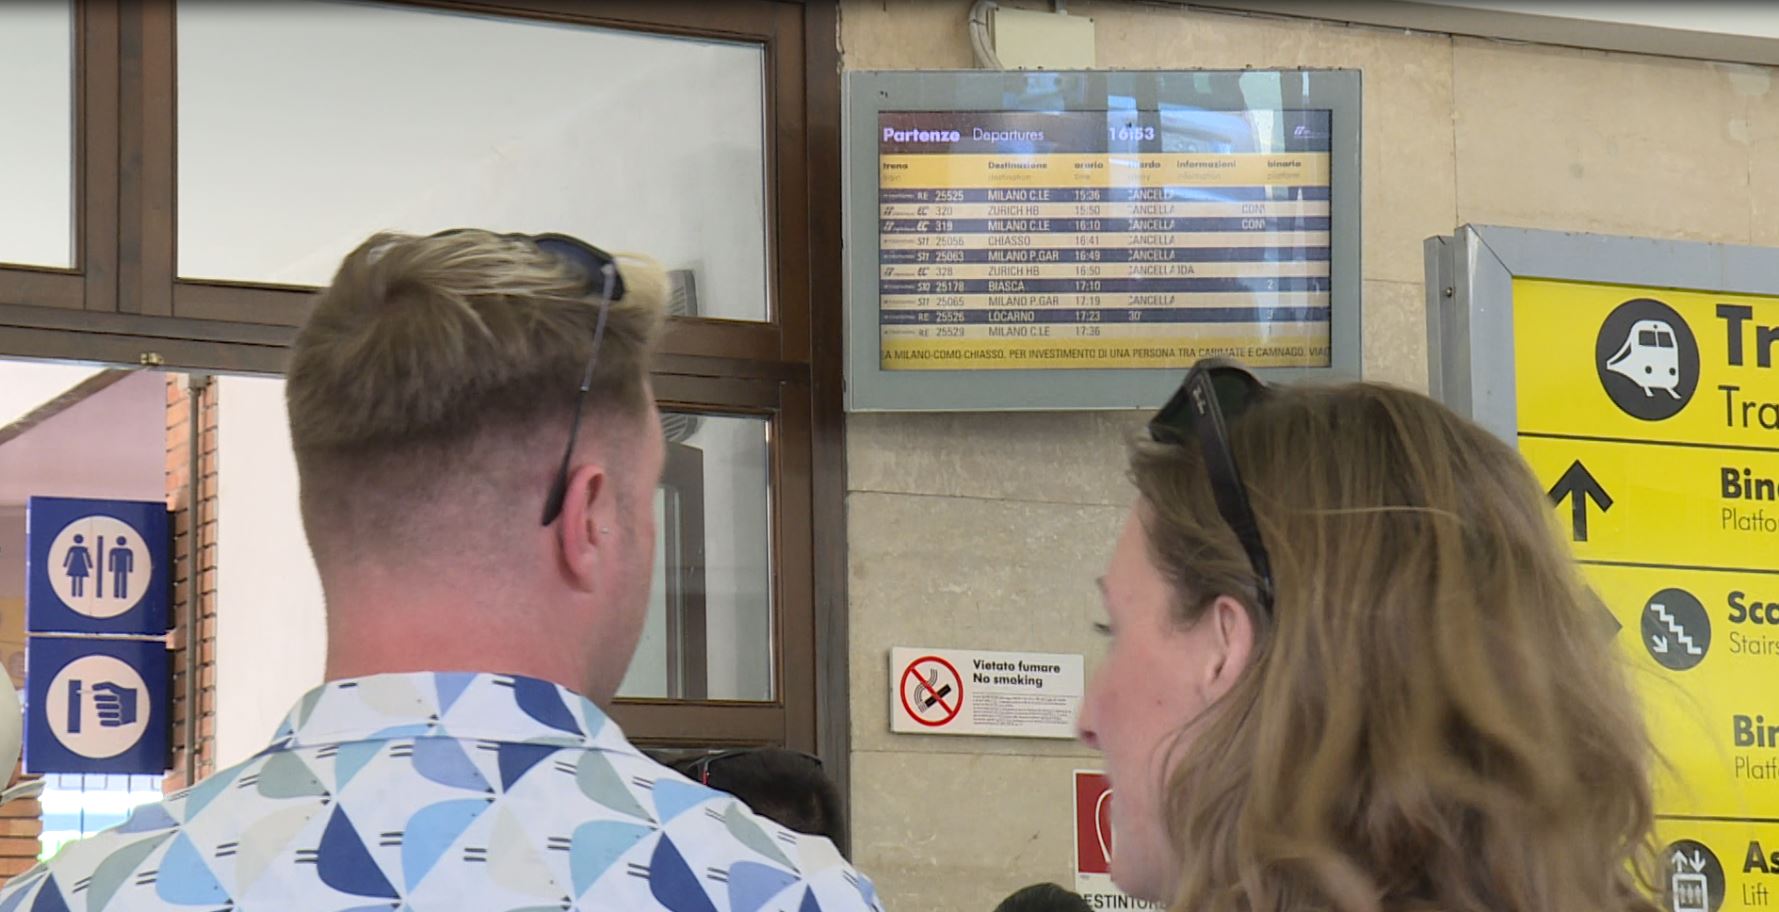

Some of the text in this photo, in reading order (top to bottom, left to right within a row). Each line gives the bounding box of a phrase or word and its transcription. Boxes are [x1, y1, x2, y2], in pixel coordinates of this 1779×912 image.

[883, 127, 1044, 143] Partenze Departures
[1109, 127, 1155, 141] 16:53
[1177, 160, 1236, 168] informazioni
[988, 190, 1027, 200] MILANO
[1029, 190, 1051, 200] C.LE
[988, 205, 1023, 216] ZURICH
[1026, 205, 1039, 216] HB
[1075, 205, 1100, 215] 15:50
[988, 220, 1027, 231] MILANO
[1029, 220, 1051, 231] C.LE
[1075, 220, 1100, 230] 16:10
[988, 235, 1031, 246] CHIASSO
[1075, 235, 1099, 246] 16:41
[988, 250, 1027, 261] MILANO
[1029, 250, 1059, 261] P.GAR
[988, 266, 1023, 276] ZURICH
[1026, 266, 1039, 276] HB
[988, 281, 1025, 292] BIASCA
[1075, 281, 1100, 291] 17:10
[988, 296, 1027, 307] MILANO
[988, 311, 1035, 322] LOCARNO
[988, 326, 1027, 337] MILANO
[1029, 326, 1051, 337] C.LE
[1009, 349, 1026, 359] PER
[1029, 348, 1096, 359] INVESTIMENTO
[1099, 348, 1107, 358] DI
[1109, 348, 1130, 358] UNA
[1133, 348, 1176, 359] PERSONA
[1179, 348, 1196, 358] TRA
[1721, 467, 1779, 501] Bin
[973, 659, 1061, 673] Vietato fumare
[973, 673, 1043, 688] No smoking
[1735, 755, 1779, 780] Platf
[1743, 883, 1769, 907] Lift
